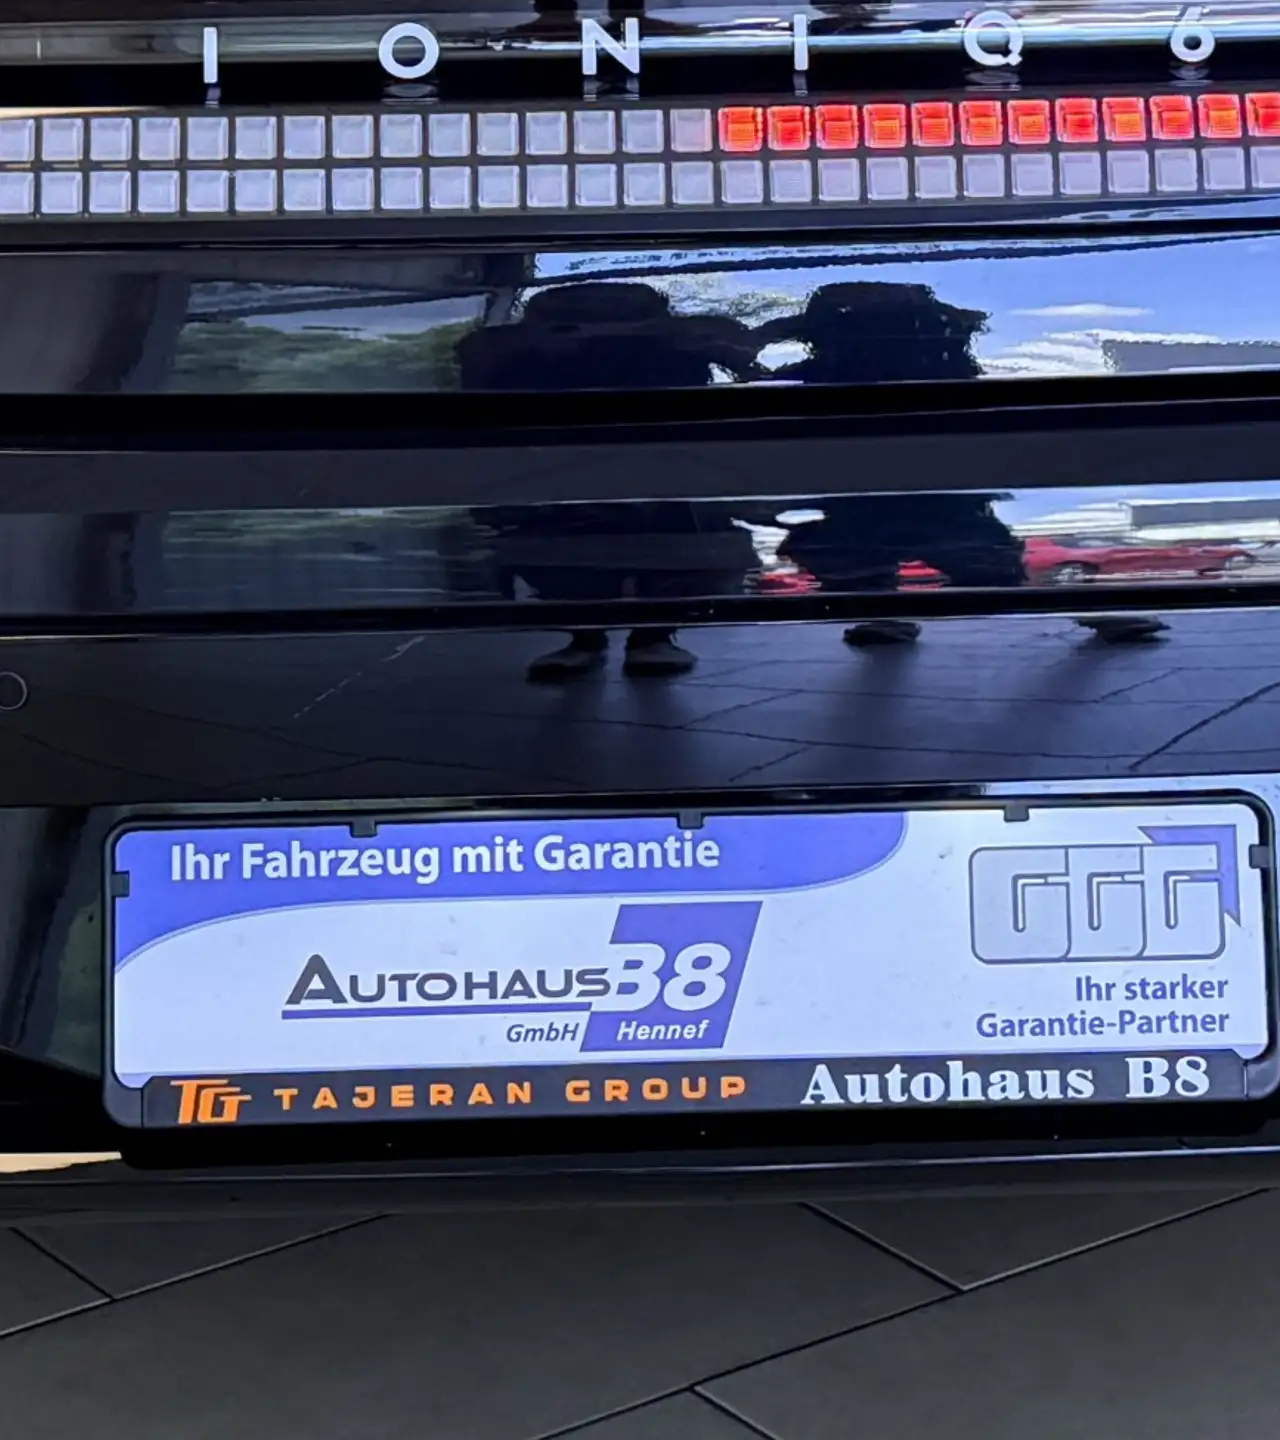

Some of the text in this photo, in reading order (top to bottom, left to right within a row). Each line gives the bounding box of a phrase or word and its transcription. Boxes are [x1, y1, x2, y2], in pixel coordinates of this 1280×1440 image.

[203, 5, 1216, 84] IONIQ 6
[170, 830, 721, 884] Ihr Fahrzeug mit Garantie
[600, 942, 733, 1013] B8
[1075, 973, 1229, 1002] Ihr starker
[505, 1018, 709, 1044] GmbH Hennef
[975, 1008, 1230, 1038] Garantie-Partner
[273, 1081, 532, 1111] TAJERAN
[564, 1075, 748, 1103] GROUP
[800, 1055, 1211, 1106] Autohaus B8
